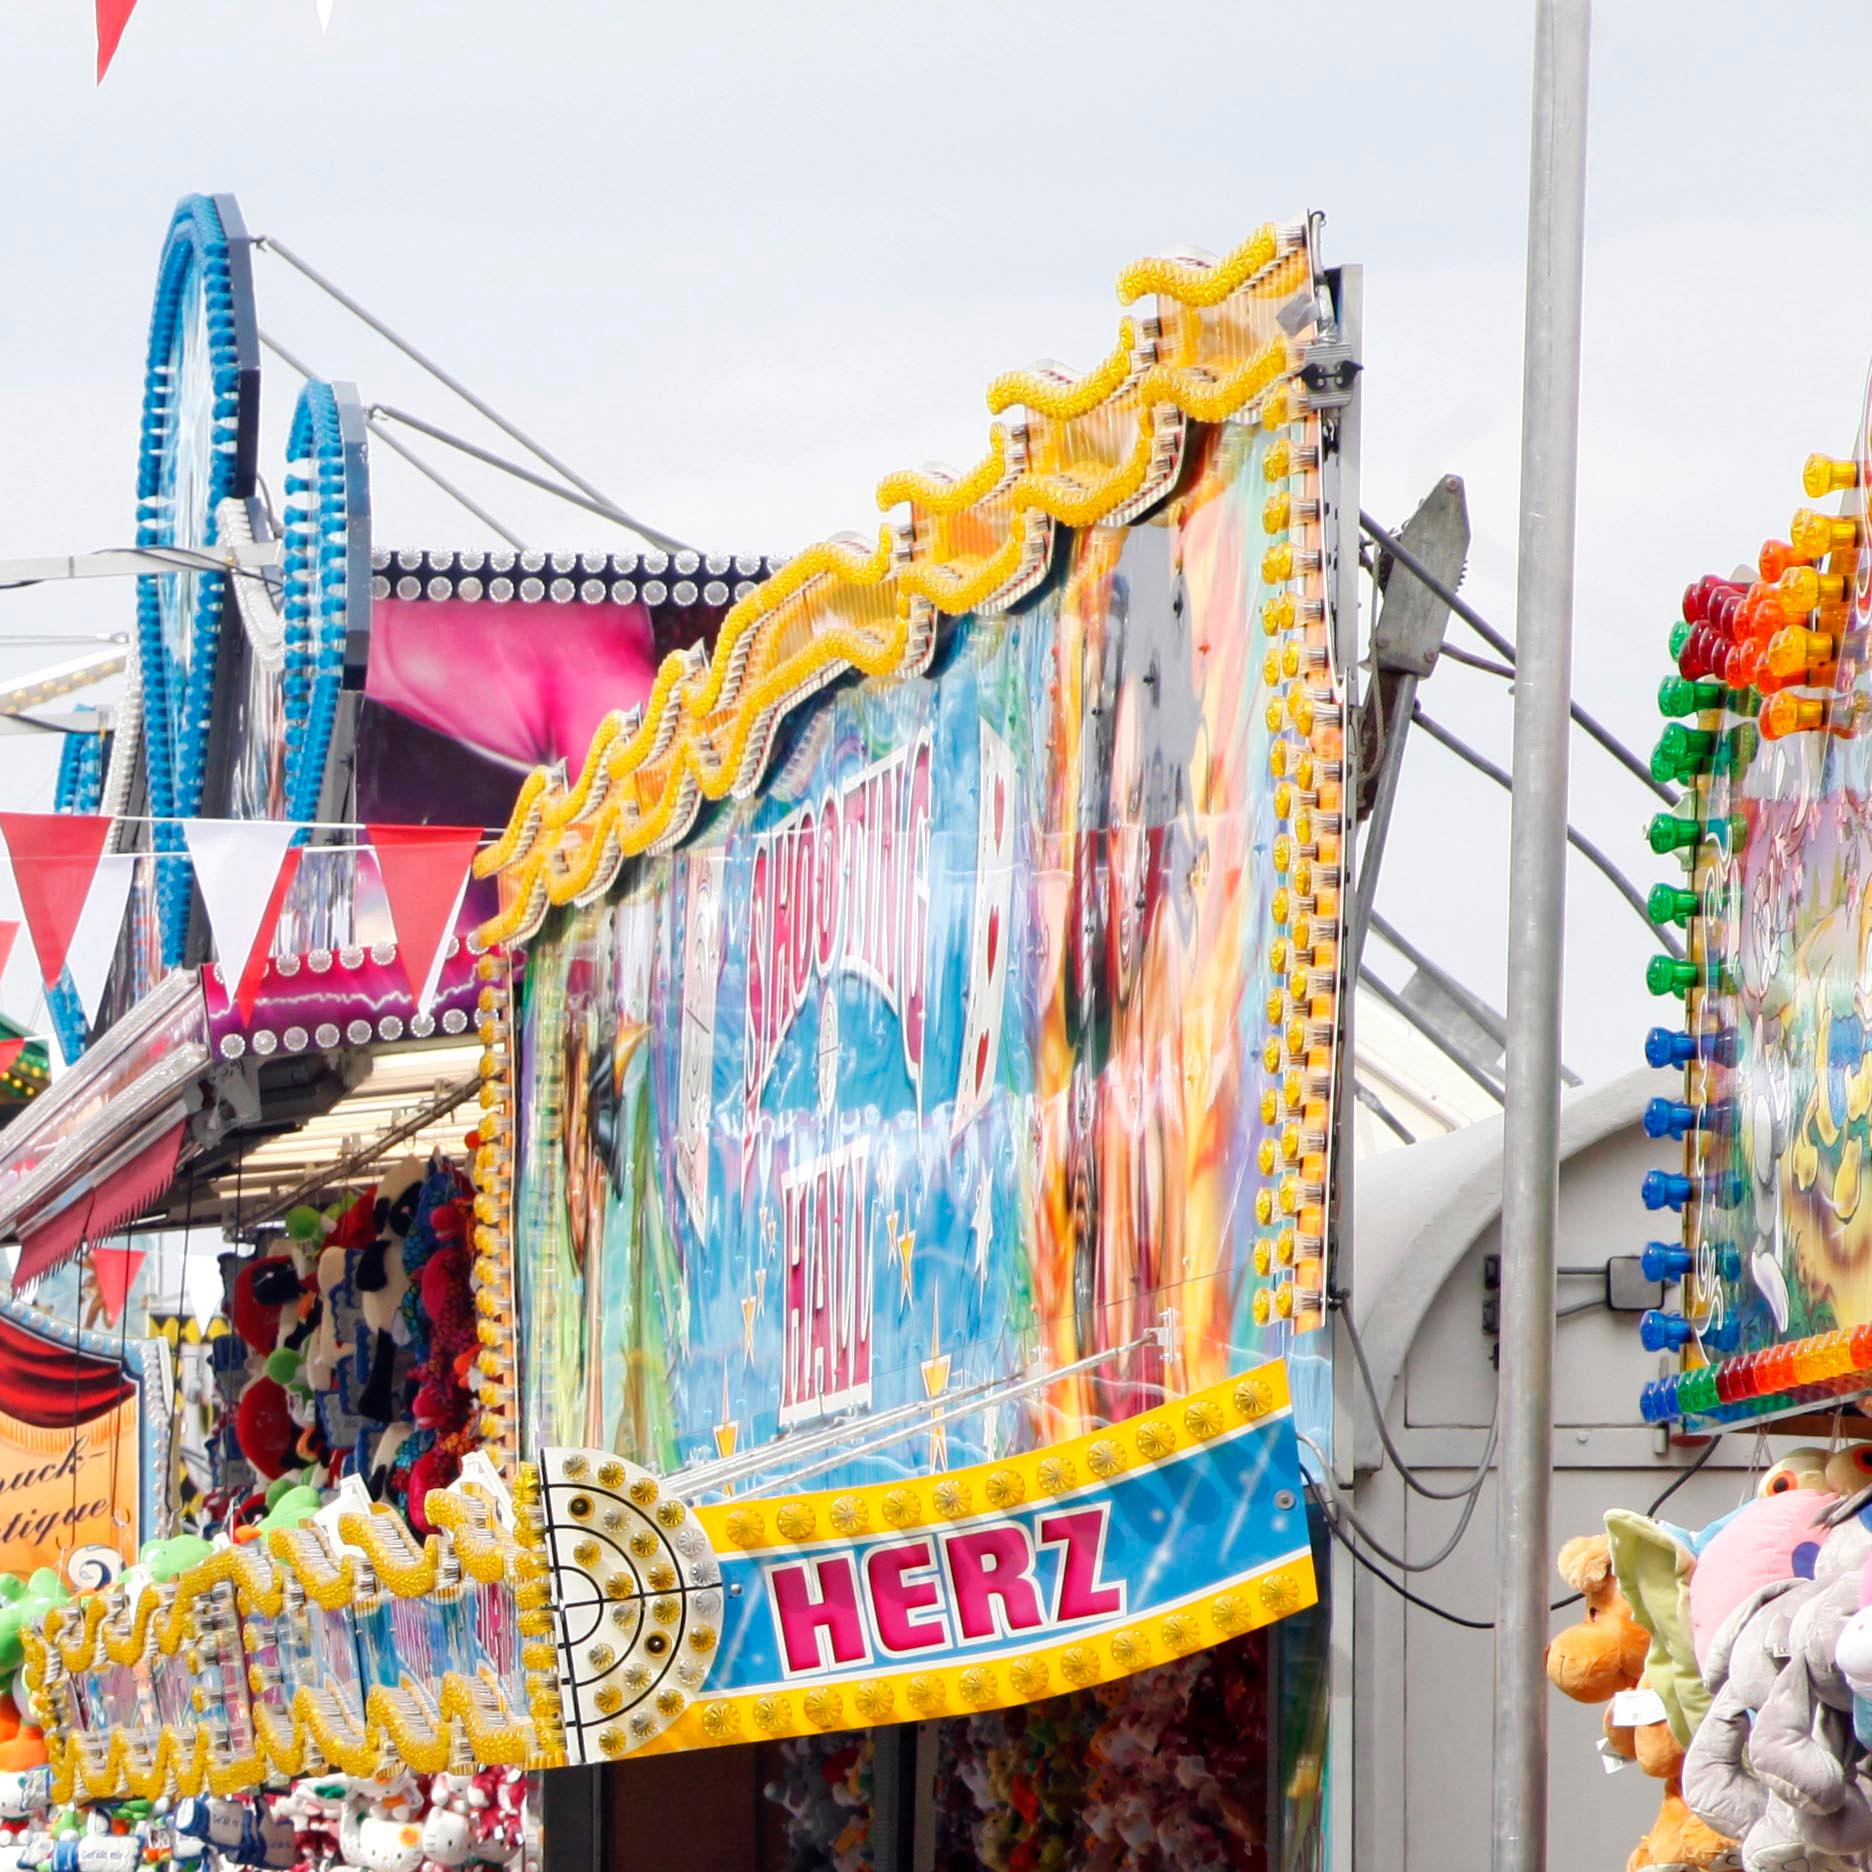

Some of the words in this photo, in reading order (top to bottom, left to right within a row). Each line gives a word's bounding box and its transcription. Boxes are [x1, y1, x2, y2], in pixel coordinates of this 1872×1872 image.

[745, 726, 934, 1170] SHOOTING
[779, 1135, 873, 1427] HALL
[765, 1501, 1127, 1680] HERZ
